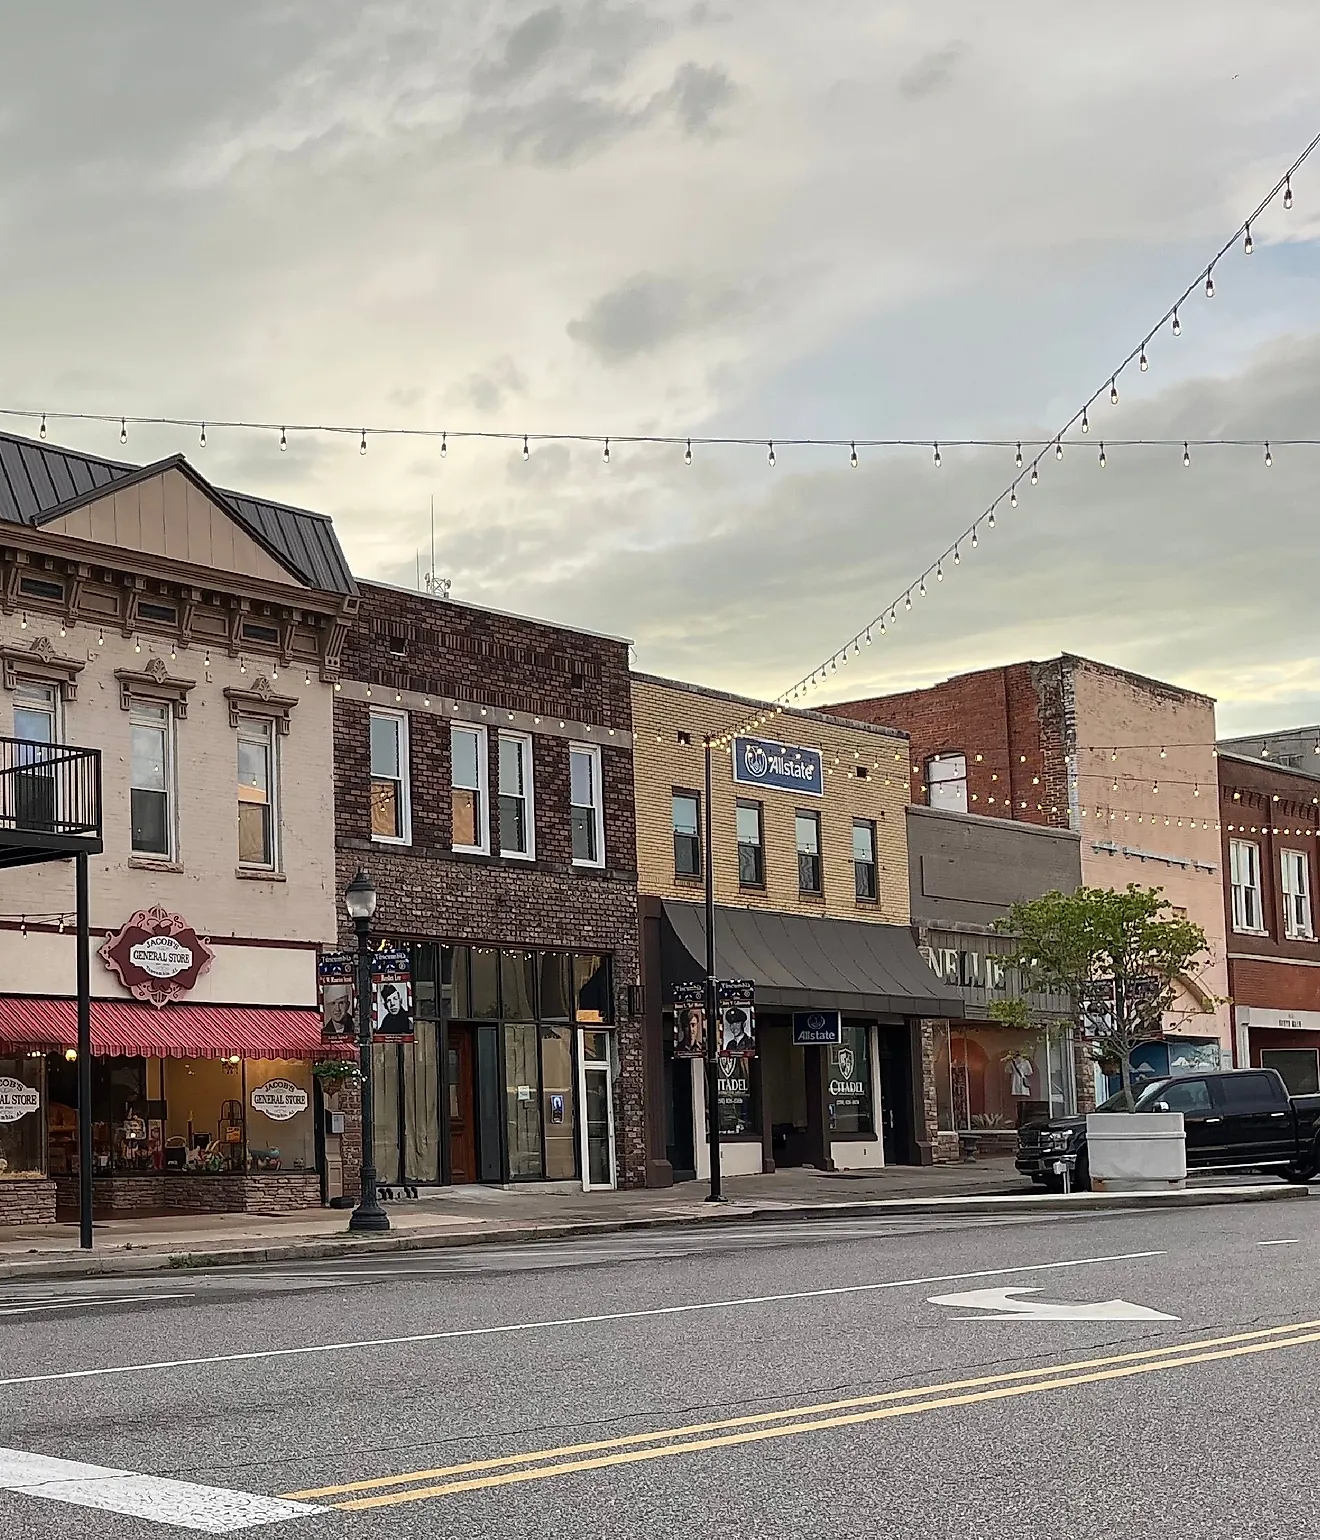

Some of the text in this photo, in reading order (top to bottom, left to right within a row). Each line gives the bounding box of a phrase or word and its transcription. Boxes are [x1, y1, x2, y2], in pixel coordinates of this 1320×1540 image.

[769, 756, 813, 780] Allstate
[146, 937, 180, 950] JACOB'S
[133, 949, 190, 964] GENERAL STORE
[798, 1030, 836, 1040] Allstate
[264, 1082, 295, 1093] JACOB'S
[717, 1078, 748, 1091] ITADEL
[829, 1079, 864, 1096] CITADEL
[11, 1095, 37, 1105] STORE
[254, 1094, 306, 1105] GENERAL STORE
